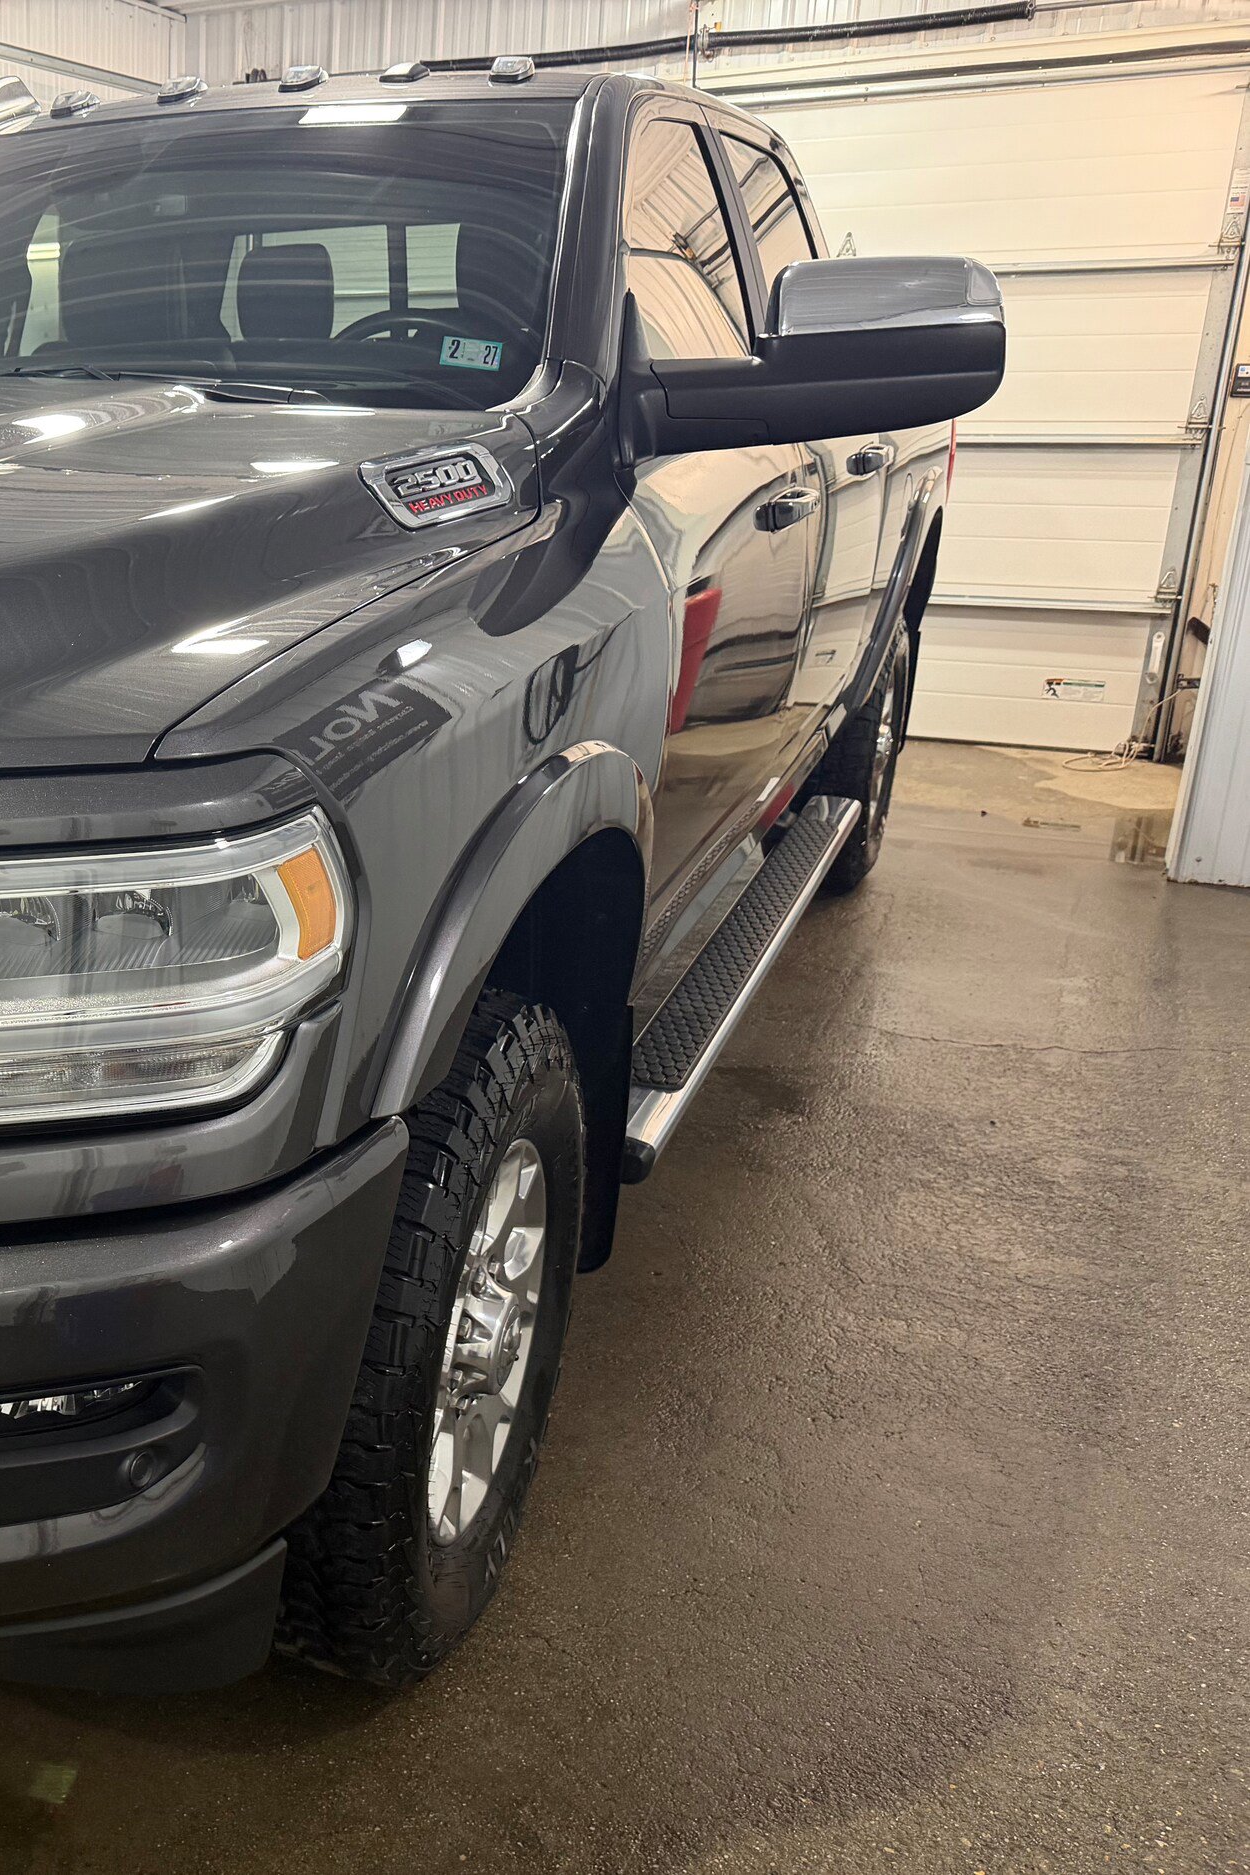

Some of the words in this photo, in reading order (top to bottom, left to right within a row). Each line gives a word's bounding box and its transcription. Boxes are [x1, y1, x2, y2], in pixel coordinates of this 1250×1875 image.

[448, 339, 461, 359] 2
[482, 345, 499, 366] 27
[392, 459, 480, 497] 2500
[408, 493, 454, 514] HEAVY
[454, 484, 488, 503] DUTY
